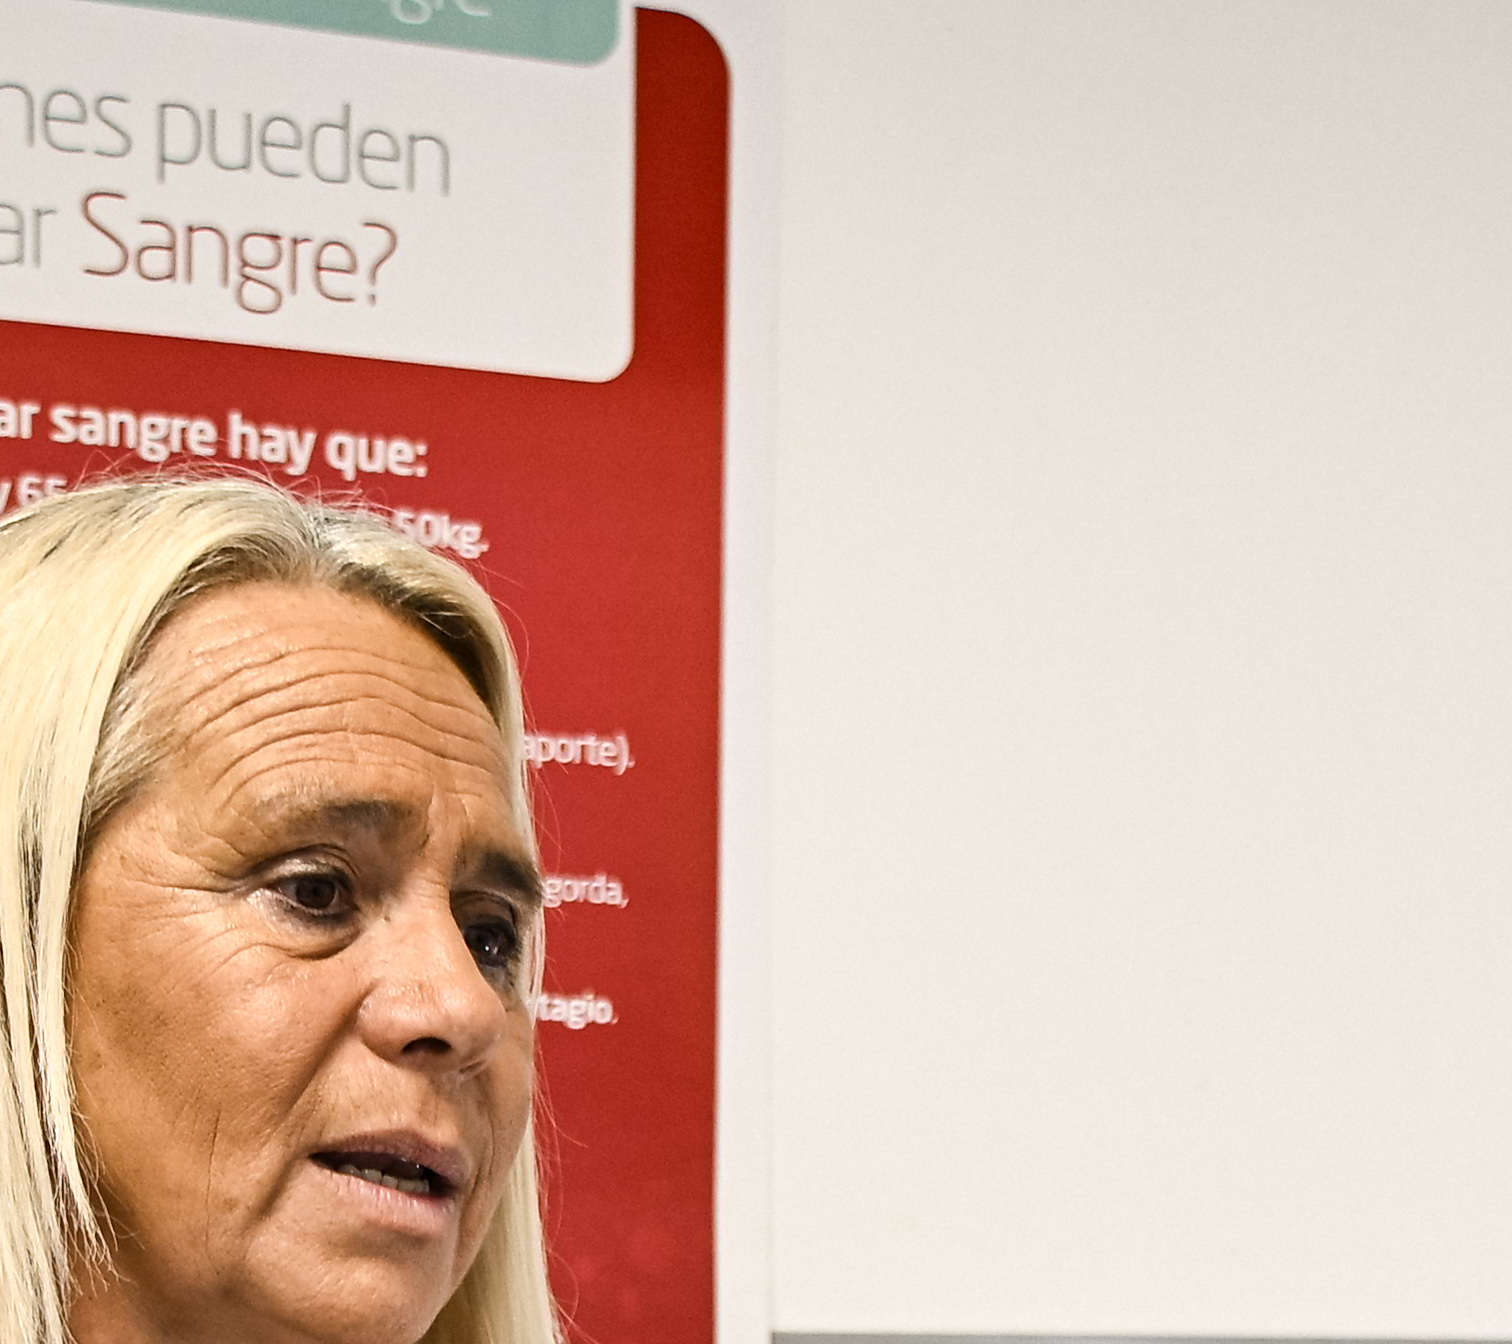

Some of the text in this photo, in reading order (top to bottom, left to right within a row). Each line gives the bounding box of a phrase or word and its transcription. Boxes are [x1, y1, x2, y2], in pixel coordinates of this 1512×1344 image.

[155, 103, 452, 197] pueden
[80, 192, 398, 314] Sangre?
[49, 402, 218, 463] sangre
[227, 409, 317, 476] hay
[325, 430, 428, 481] que:
